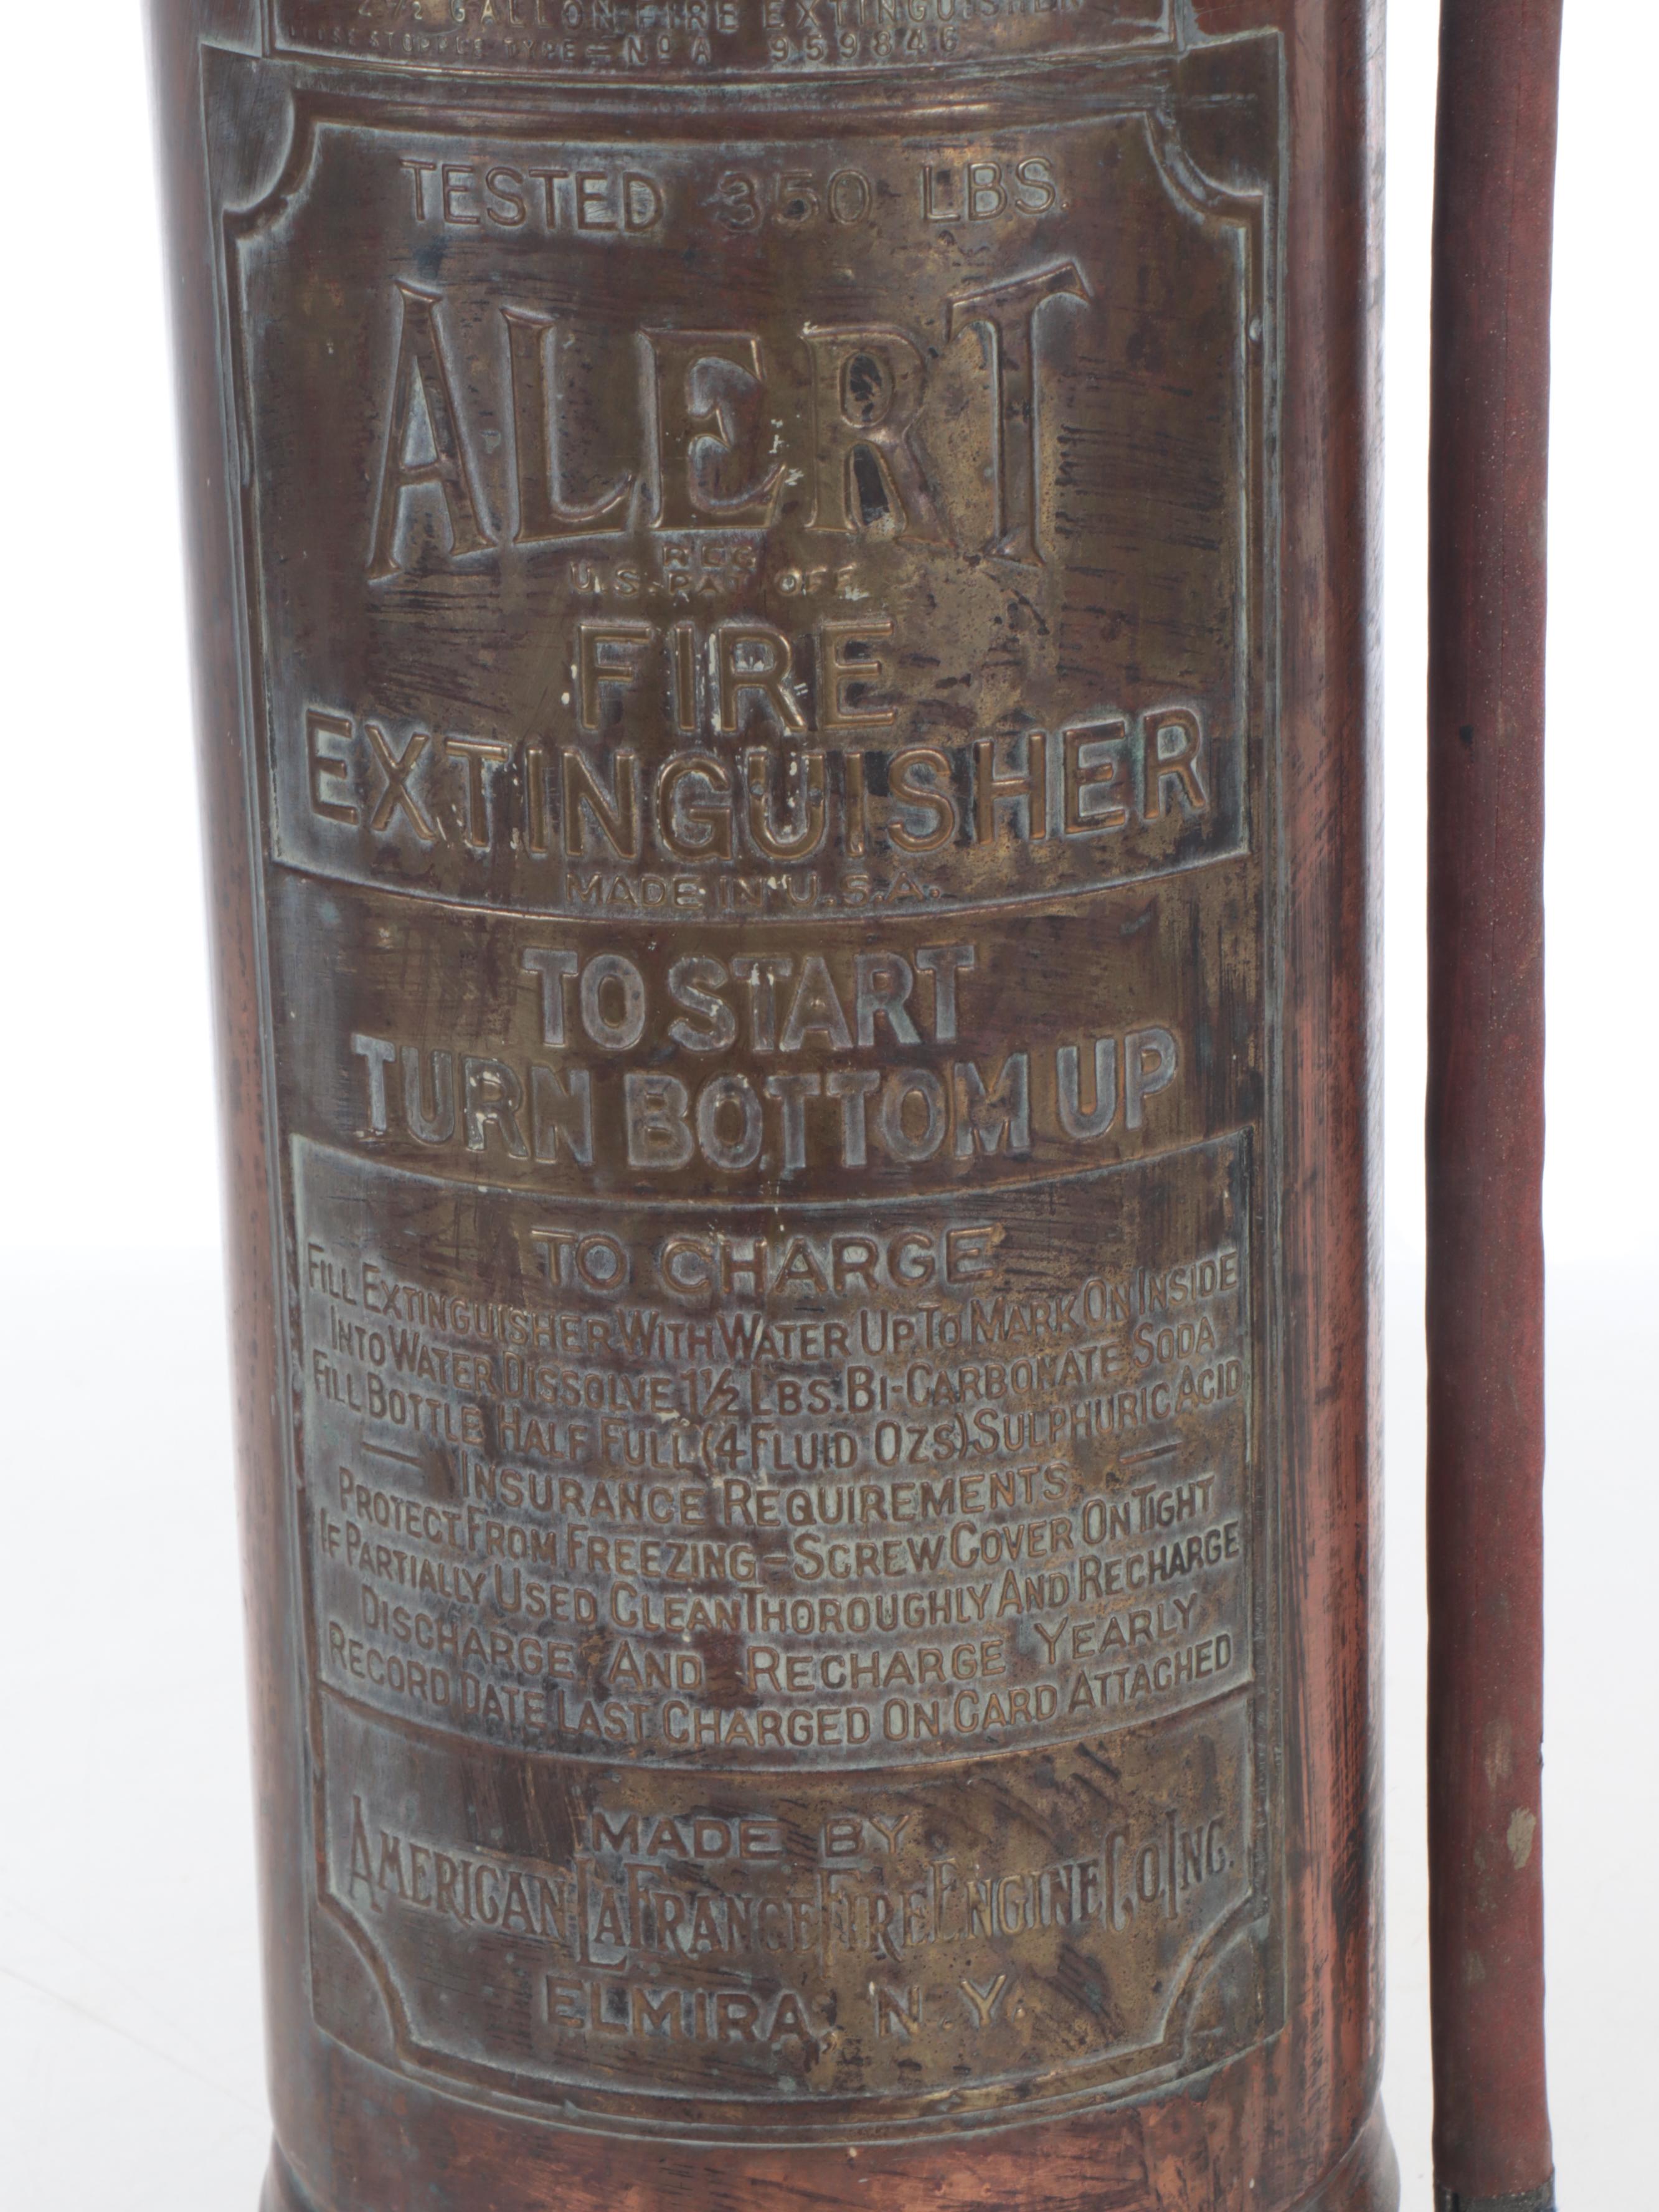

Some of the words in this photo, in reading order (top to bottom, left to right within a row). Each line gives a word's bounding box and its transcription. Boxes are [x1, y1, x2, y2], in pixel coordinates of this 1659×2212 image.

[504, 38, 575, 62] TYPE
[691, 35, 711, 63] A
[769, 26, 958, 62] 959846
[636, 0, 739, 32] FIRE
[399, 158, 664, 234] TESTED
[716, 168, 871, 234] 350
[922, 156, 1069, 224] LBS.
[366, 256, 1094, 584] ALERT
[579, 622, 897, 732] FIRE
[306, 707, 1207, 861] EXTINGUISHER
[564, 873, 704, 910] MADE
[718, 873, 765, 909] IN
[787, 872, 942, 908] U.S.A.
[522, 946, 646, 1050] TO
[668, 945, 975, 1052] START
[351, 1033, 593, 1166] TURN
[624, 1051, 1030, 1171] BOTTOM
[1057, 1026, 1179, 1141] UP
[308, 1242, 357, 1305] FILL
[361, 1262, 613, 1354] EXTINGUISHER
[615, 1308, 714, 1360] WITH
[716, 1312, 852, 1361] WATER
[860, 1308, 916, 1356] UP
[917, 1303, 963, 1349] TO
[970, 1295, 1080, 1346] MARK
[1082, 1278, 1132, 1328] ON
[1137, 1250, 1239, 1315] INSIDE
[531, 1227, 624, 1292] TO
[661, 1224, 997, 1296] CHARGE
[313, 1348, 361, 1412] FILL
[367, 1371, 483, 1444] BOTTLE
[499, 1404, 588, 1459] HALF
[600, 1418, 689, 1470] FULL
[701, 1424, 747, 1472] (4
[750, 1422, 858, 1471] FLUID
[874, 1412, 968, 1467] OZS)
[972, 1382, 1171, 1456] SULPHURIC
[1175, 1359, 1245, 1413] ACID
[330, 1305, 386, 1367] INTO
[387, 1324, 497, 1396] WATER
[503, 1350, 675, 1414] DISSOLVE
[750, 1369, 844, 1417] LBS.
[846, 1341, 1122, 1414] BI-CARBONATE
[1133, 1316, 1216, 1369] SODA
[338, 1466, 461, 1548] PROTECT
[466, 1505, 557, 1566] FROM
[567, 1523, 756, 1582] FREEZING
[793, 1533, 945, 1581] SCREW
[950, 1518, 1074, 1569] COVER
[1082, 1499, 1131, 1544] ON
[1132, 1475, 1216, 1533] TIGHT
[461, 1450, 706, 1525] INSURANCE
[722, 1462, 1070, 1527] REQUIREMENTS
[320, 1507, 341, 1558] IF
[345, 1520, 487, 1605] PARTIALLY
[494, 1563, 598, 1625] USED
[610, 1581, 742, 1633] CLEAN
[739, 1582, 992, 1635] THOROUGHLY
[997, 1569, 1071, 1618] AND
[1079, 1520, 1241, 1602] RECHARGE
[329, 1620, 451, 1706] RECORD
[460, 1671, 547, 1729] DATE
[557, 1688, 649, 1742] LAST
[662, 1699, 871, 1747] CHARGED
[882, 1697, 940, 1742] ON
[953, 1685, 1058, 1733] CARD
[1067, 1633, 1232, 1714] ATTACHED
[361, 1582, 575, 1680] DISCHARGE
[608, 1639, 703, 1690] AND
[748, 1640, 1006, 1693] RECHARGE
[1034, 1593, 1198, 1665] YEARLY
[349, 1794, 565, 1940] AMERICAN
[818, 1868, 928, 1978] FIRE
[930, 1859, 1103, 1943] ENGINE
[1104, 1828, 1165, 1932] CO.
[1165, 1808, 1235, 1920] INC.
[592, 1813, 783, 1860] MADE
[824, 1814, 914, 1858] BY
